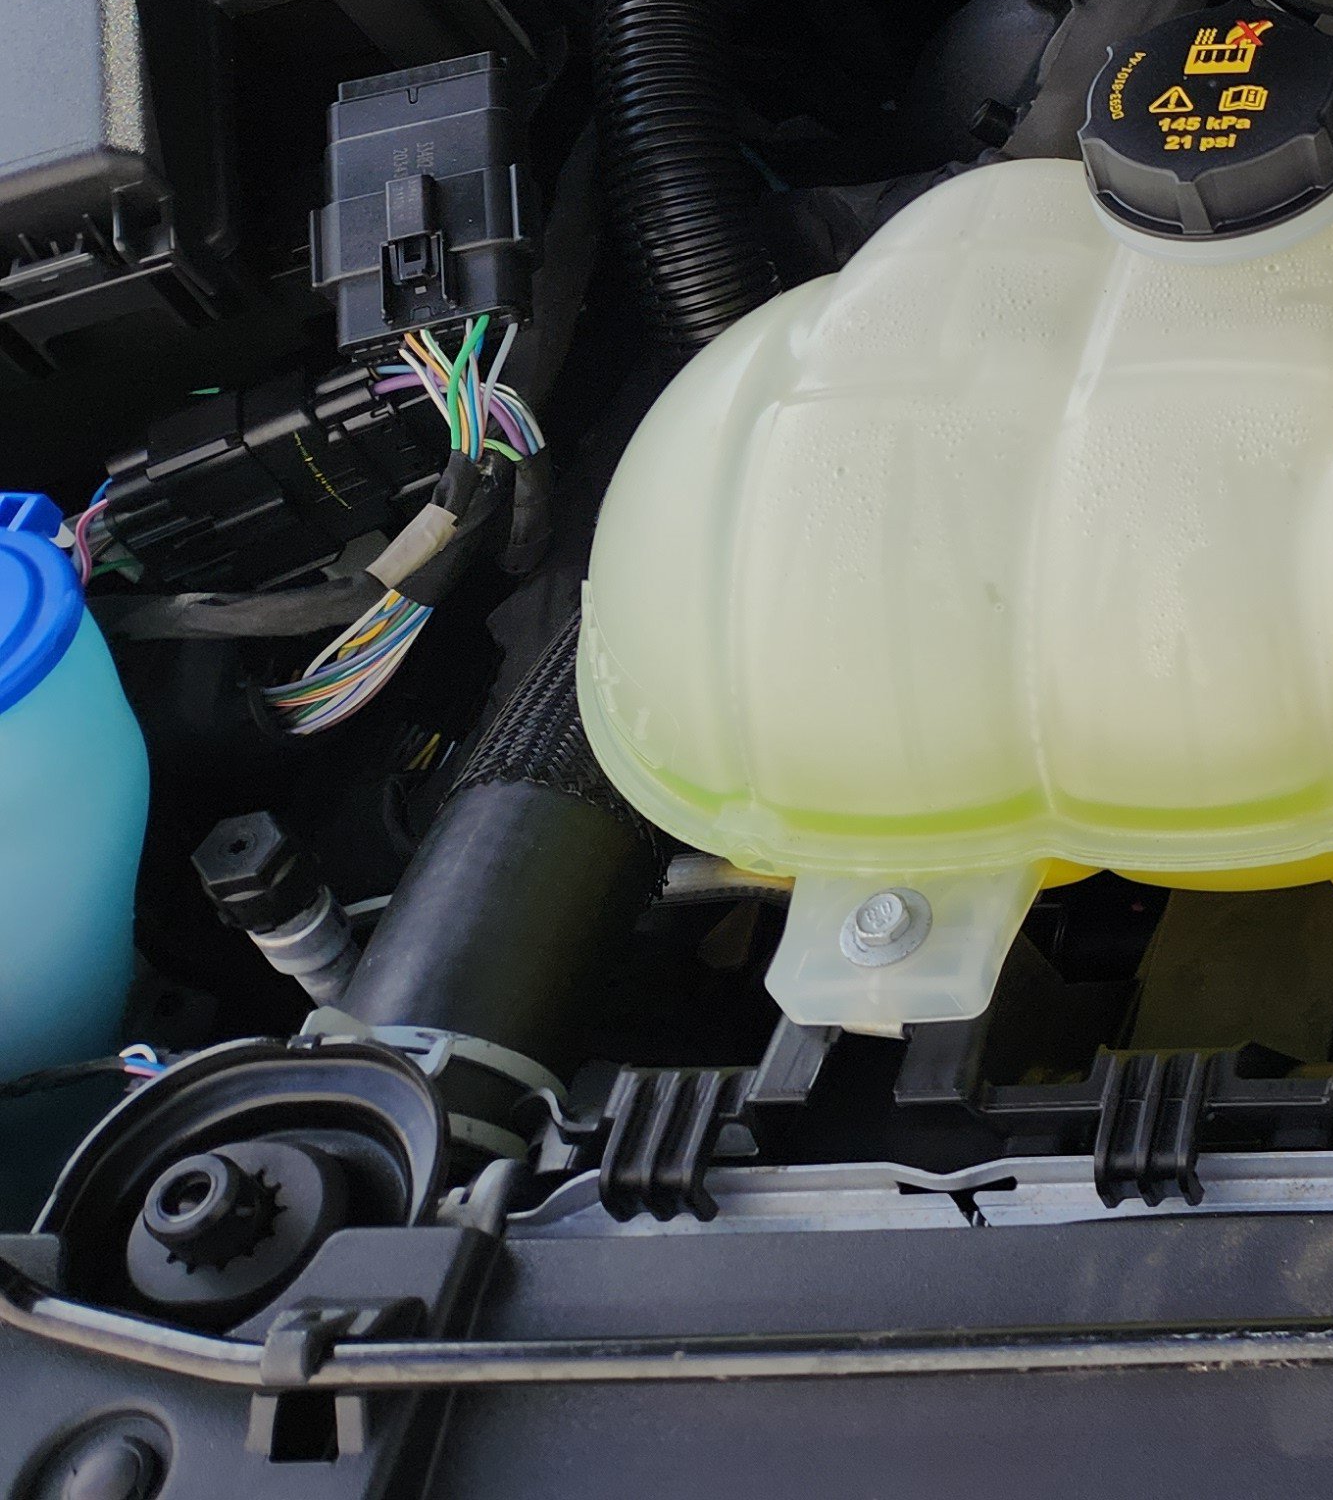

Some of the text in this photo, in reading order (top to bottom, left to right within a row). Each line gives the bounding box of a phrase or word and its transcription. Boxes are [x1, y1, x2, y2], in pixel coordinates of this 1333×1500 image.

[1158, 115, 1252, 133] 145 kPa
[1163, 133, 1238, 152] 21 psi
